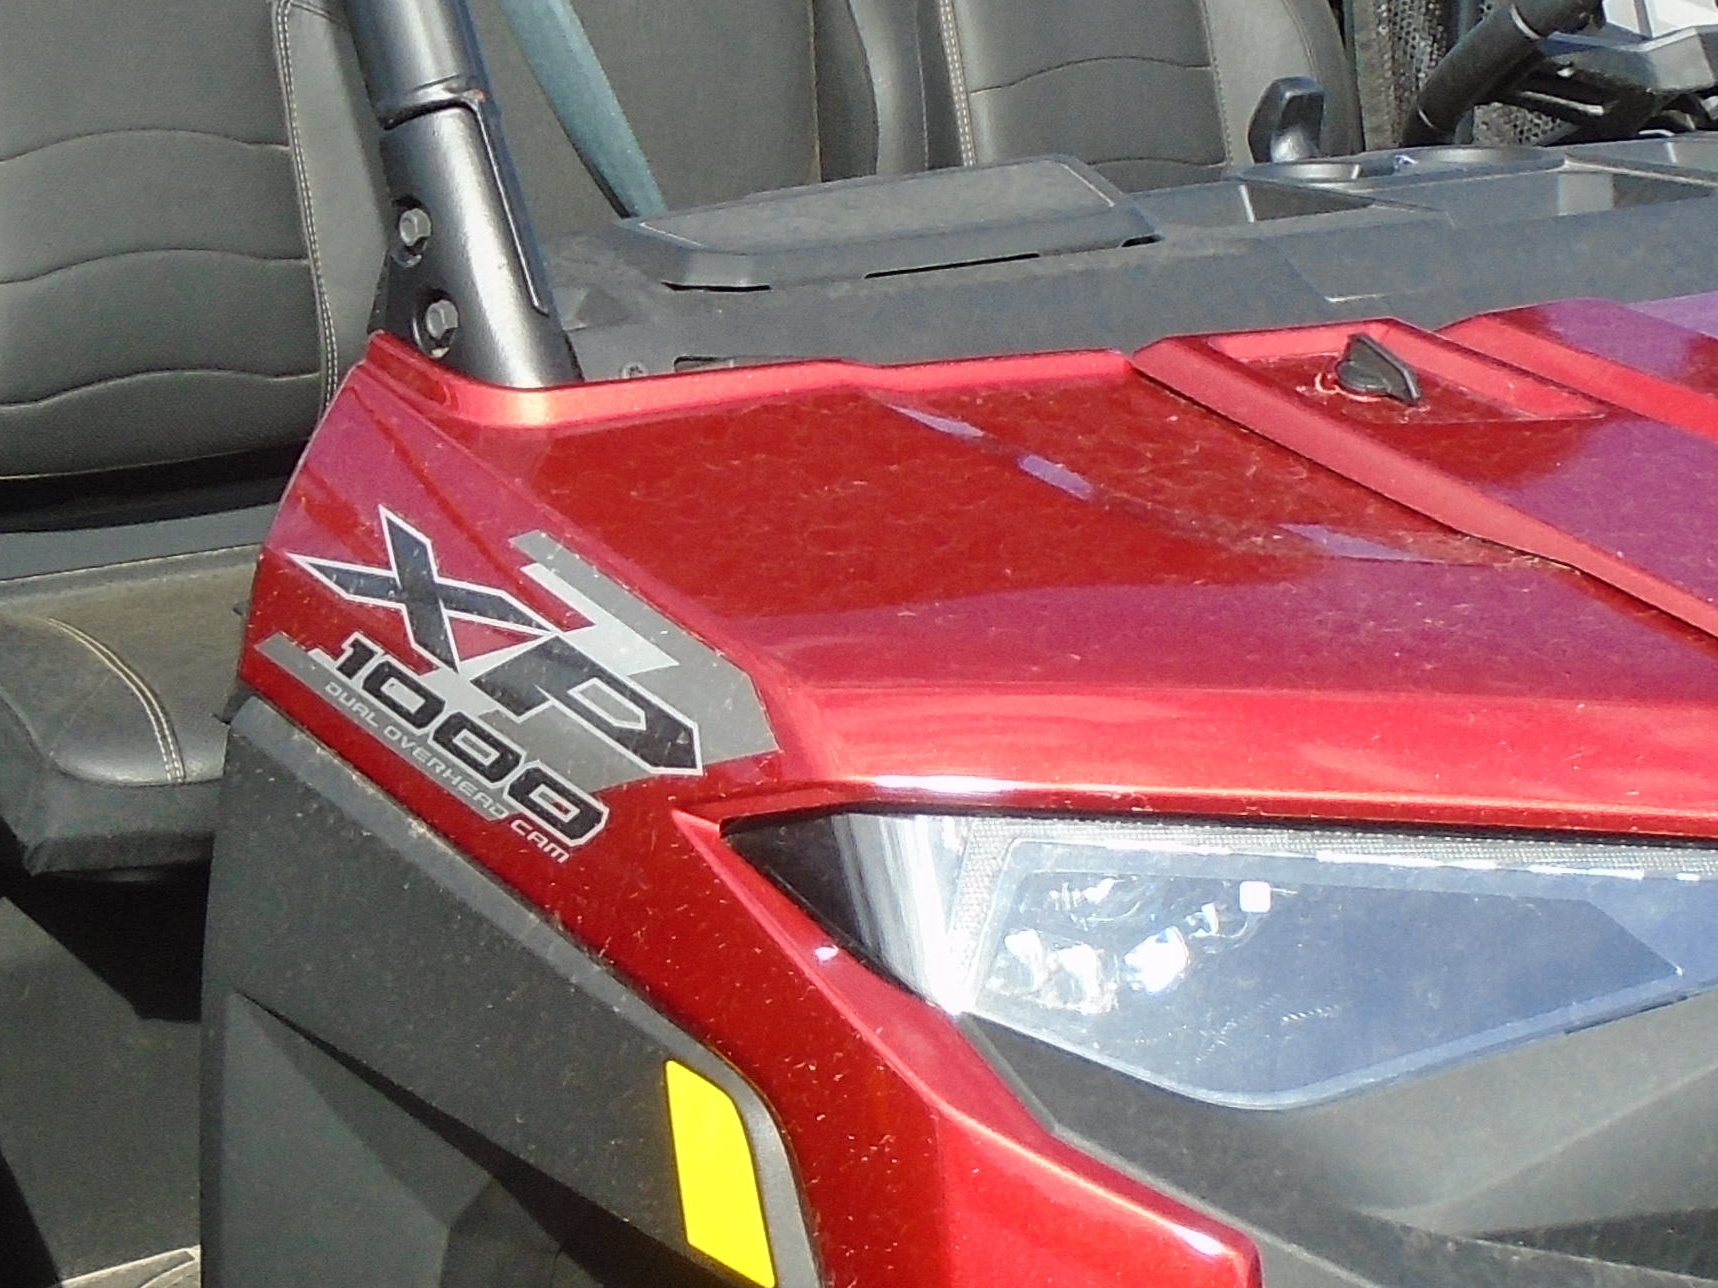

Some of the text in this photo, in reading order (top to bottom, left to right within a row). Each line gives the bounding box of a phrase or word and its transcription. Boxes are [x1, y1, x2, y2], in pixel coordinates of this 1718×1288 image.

[287, 505, 703, 777] XP
[310, 630, 611, 848] 1000
[324, 681, 571, 864] DUAL OVERHEAD CAM
